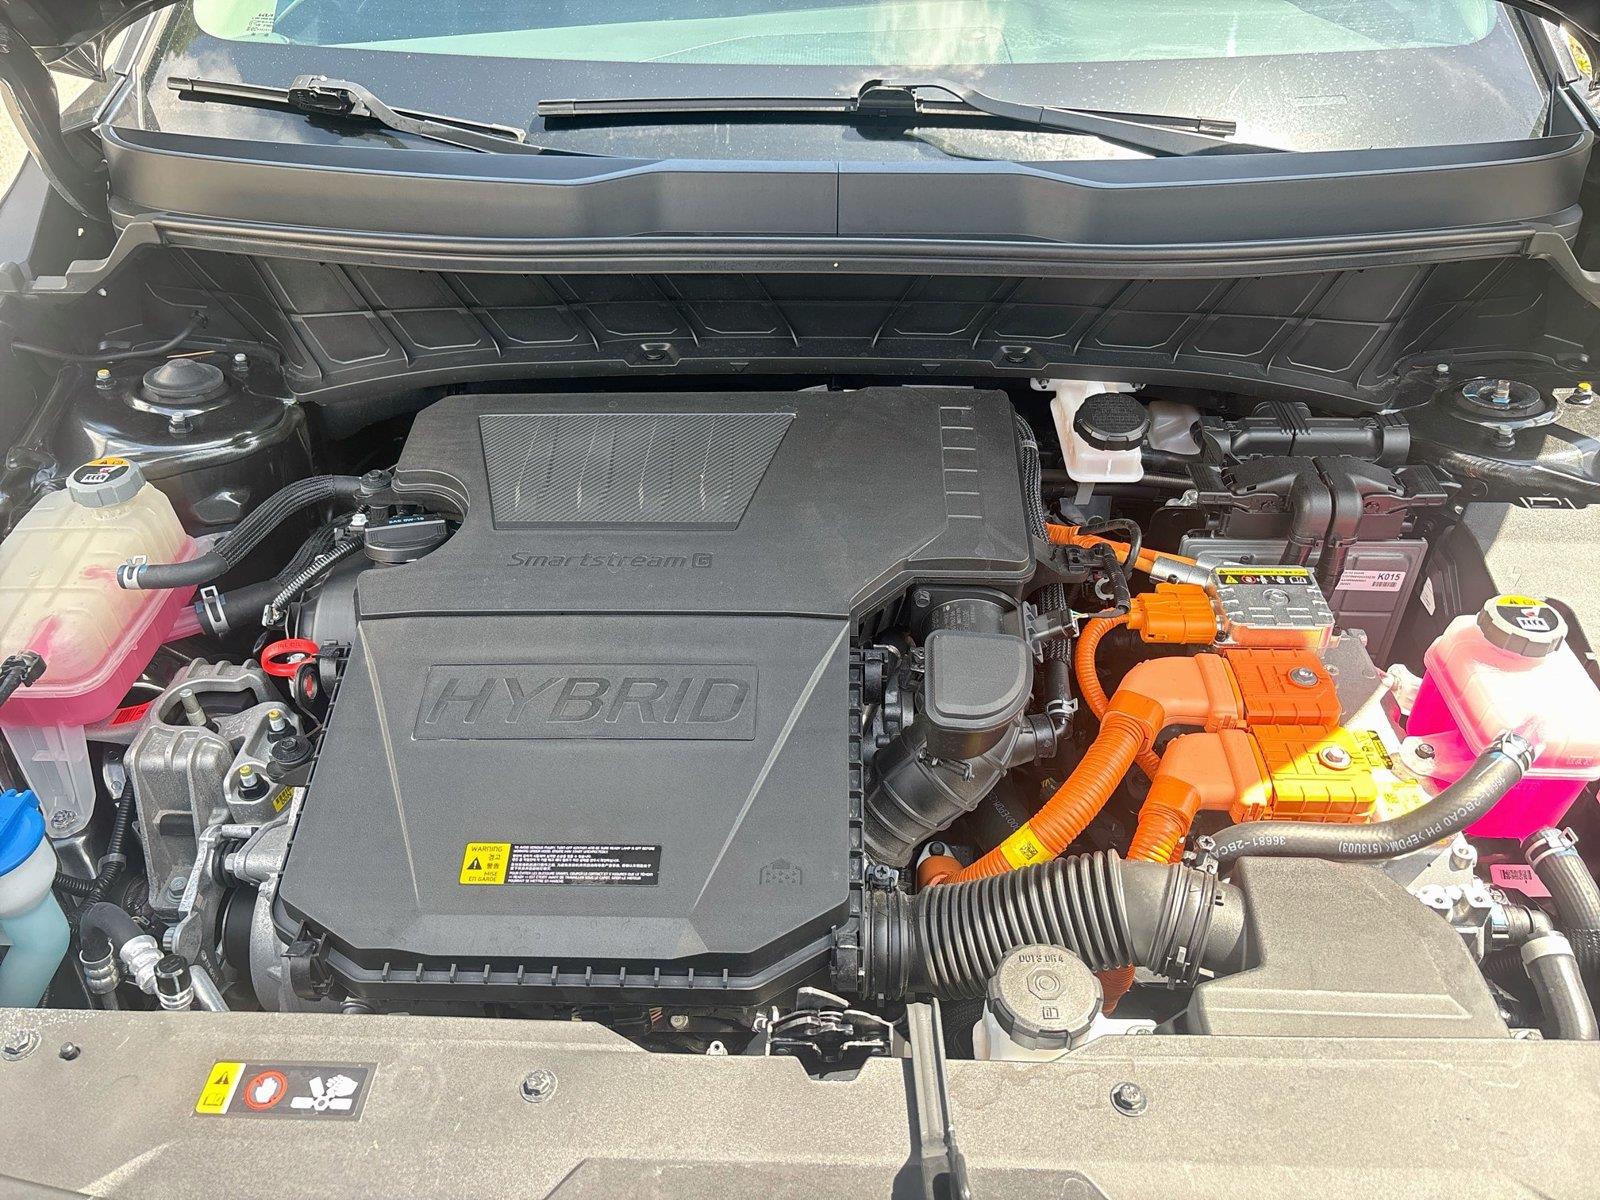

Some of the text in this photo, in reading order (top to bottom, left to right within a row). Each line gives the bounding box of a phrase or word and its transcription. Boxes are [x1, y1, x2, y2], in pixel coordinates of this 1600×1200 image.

[506, 552, 687, 568] Smartstream
[1377, 573, 1401, 581] K015
[424, 677, 749, 724] HYBRID
[1425, 823, 1443, 838] PH
[471, 845, 503, 853] WARNING
